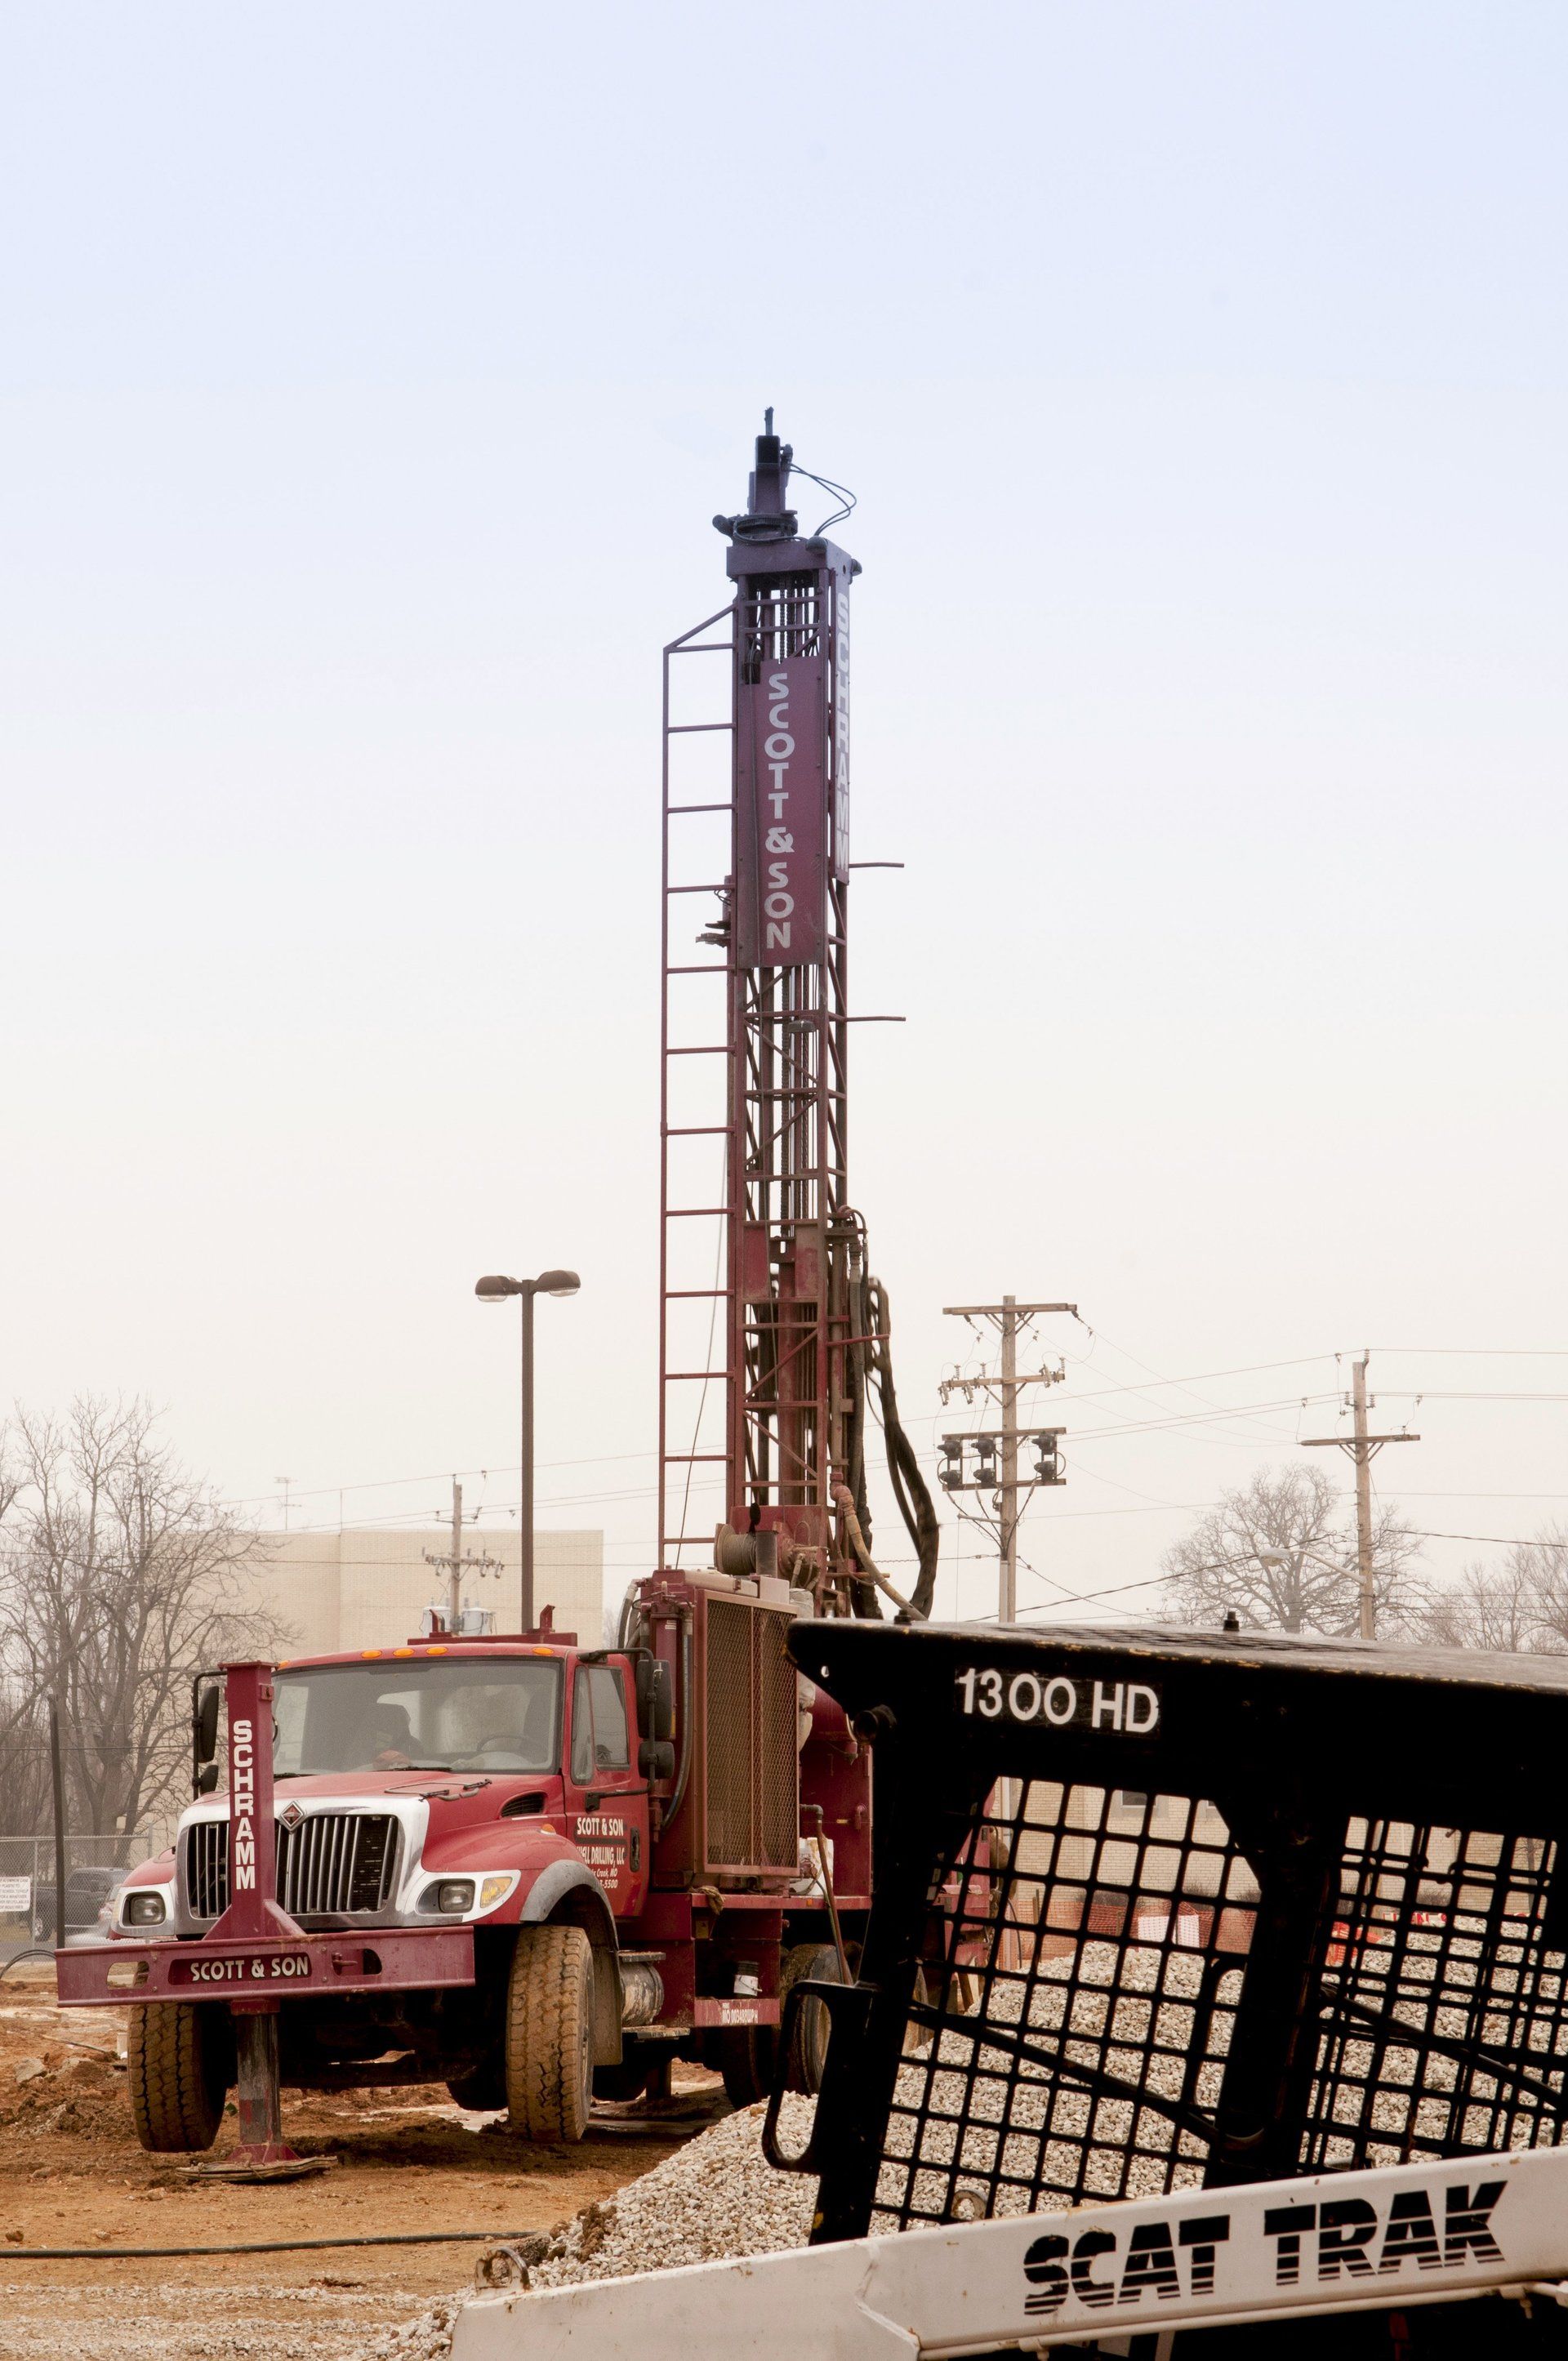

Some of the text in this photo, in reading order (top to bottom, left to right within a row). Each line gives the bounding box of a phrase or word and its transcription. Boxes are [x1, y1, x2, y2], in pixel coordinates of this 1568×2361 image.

[835, 592, 850, 873] SCHRAMM
[764, 672, 795, 949] SCOTT & SON
[958, 1668, 1159, 1733] 1300 HD
[233, 1720, 256, 1890] SCHRAMM
[577, 1817, 624, 1836] SCOTT & SON
[609, 1868, 618, 1878] MO
[616, 1847, 625, 1865] LLC
[599, 1879, 618, 1889] 3-5500
[190, 1956, 309, 1981] SCOTT & SON
[1023, 2180, 1508, 2315] SCAT TRAK
